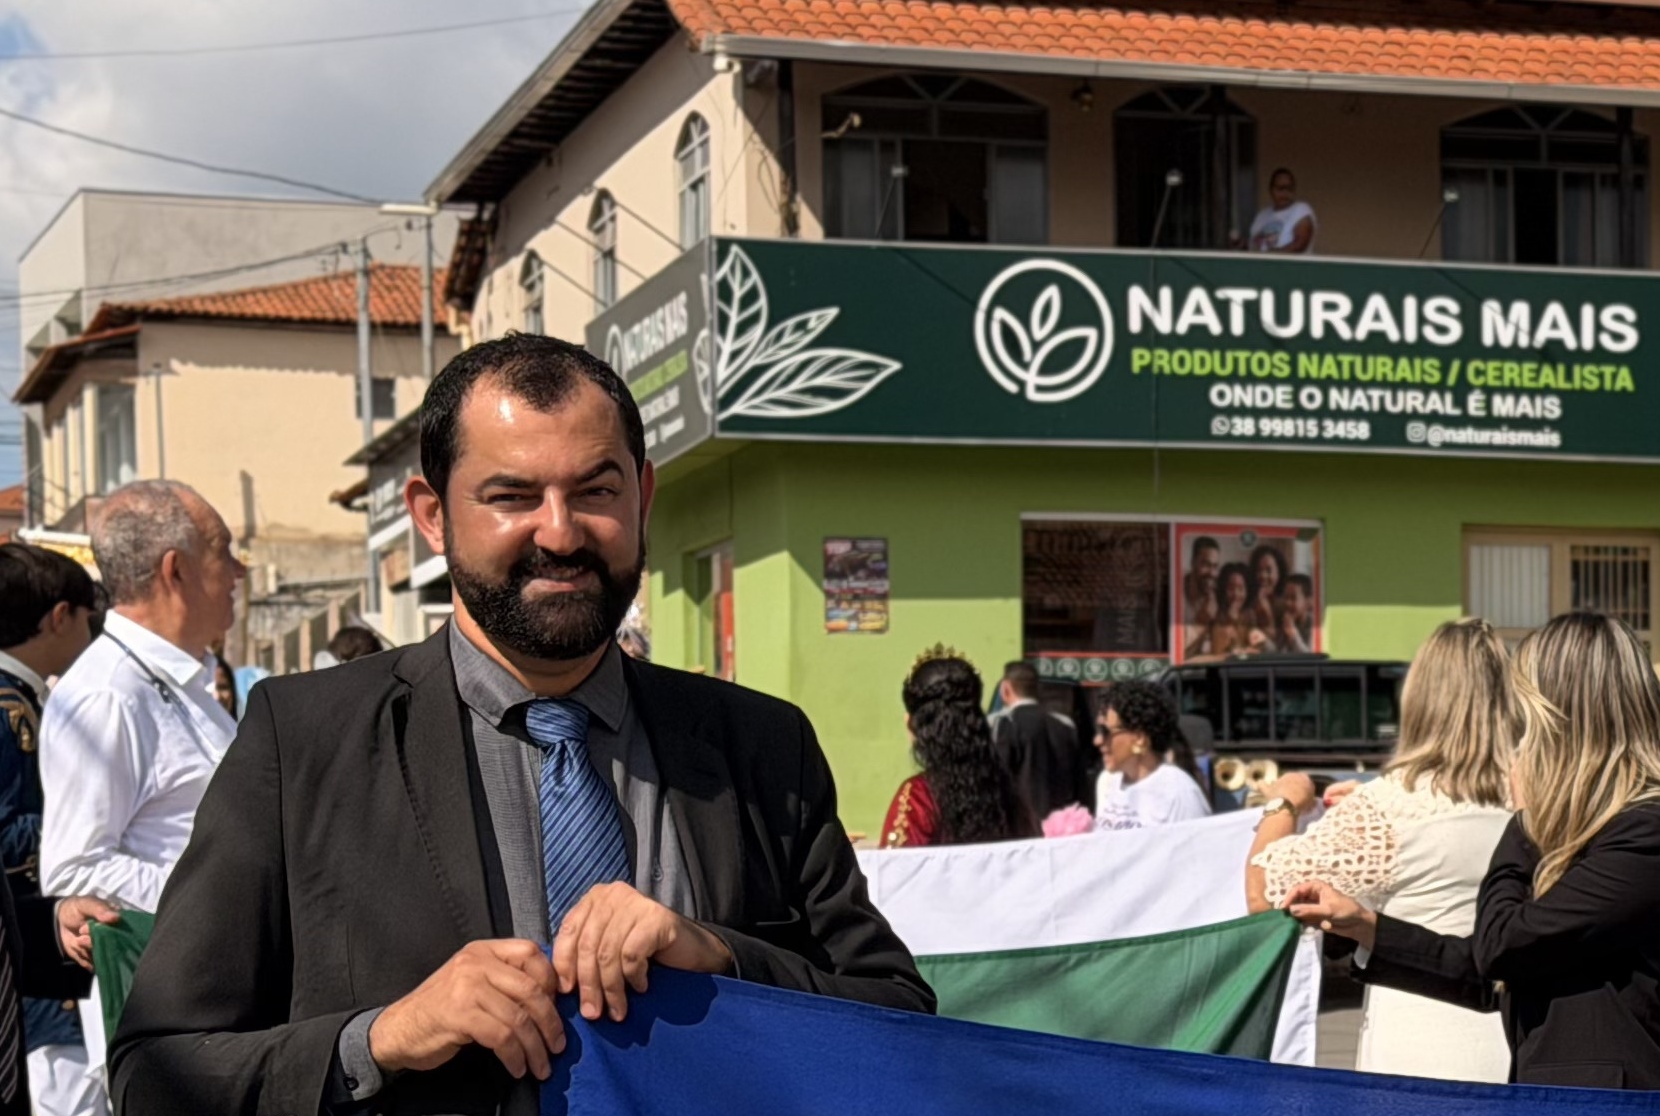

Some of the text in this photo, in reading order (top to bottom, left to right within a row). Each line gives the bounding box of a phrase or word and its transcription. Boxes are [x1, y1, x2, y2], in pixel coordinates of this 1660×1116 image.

[1127, 285, 1639, 353] NATURAIS MAIS
[1131, 348, 1635, 392] PRODUTOS NATURAIS / CEREALISTA
[1209, 383, 1562, 420] ONDE O NATURAL É MAIS
[1230, 417, 1256, 436] 38
[1322, 420, 1370, 440] 3458
[1427, 424, 1562, 448] @naturaismais
